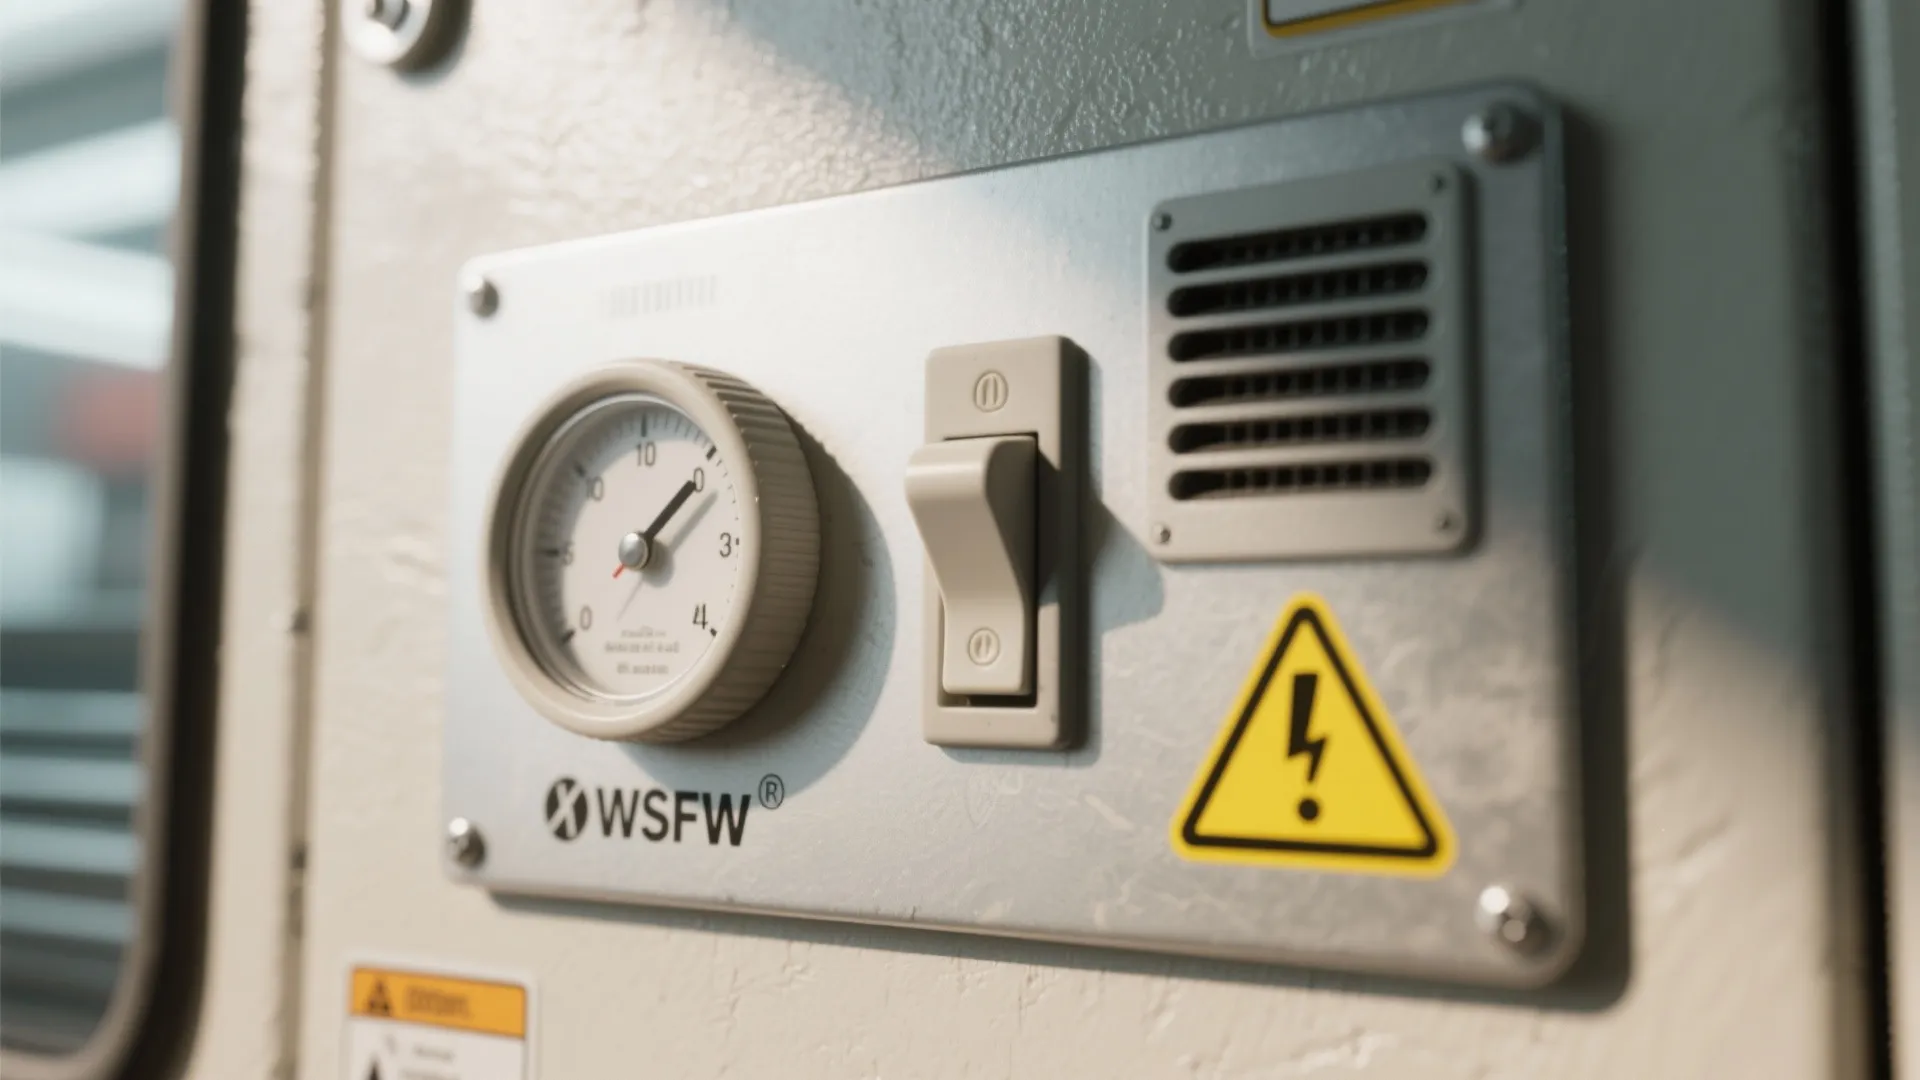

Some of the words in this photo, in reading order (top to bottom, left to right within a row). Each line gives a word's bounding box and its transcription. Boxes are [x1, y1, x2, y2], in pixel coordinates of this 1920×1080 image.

[637, 441, 656, 467] 10
[719, 531, 731, 558] 3
[579, 604, 592, 631] 0
[692, 603, 708, 630] 4
